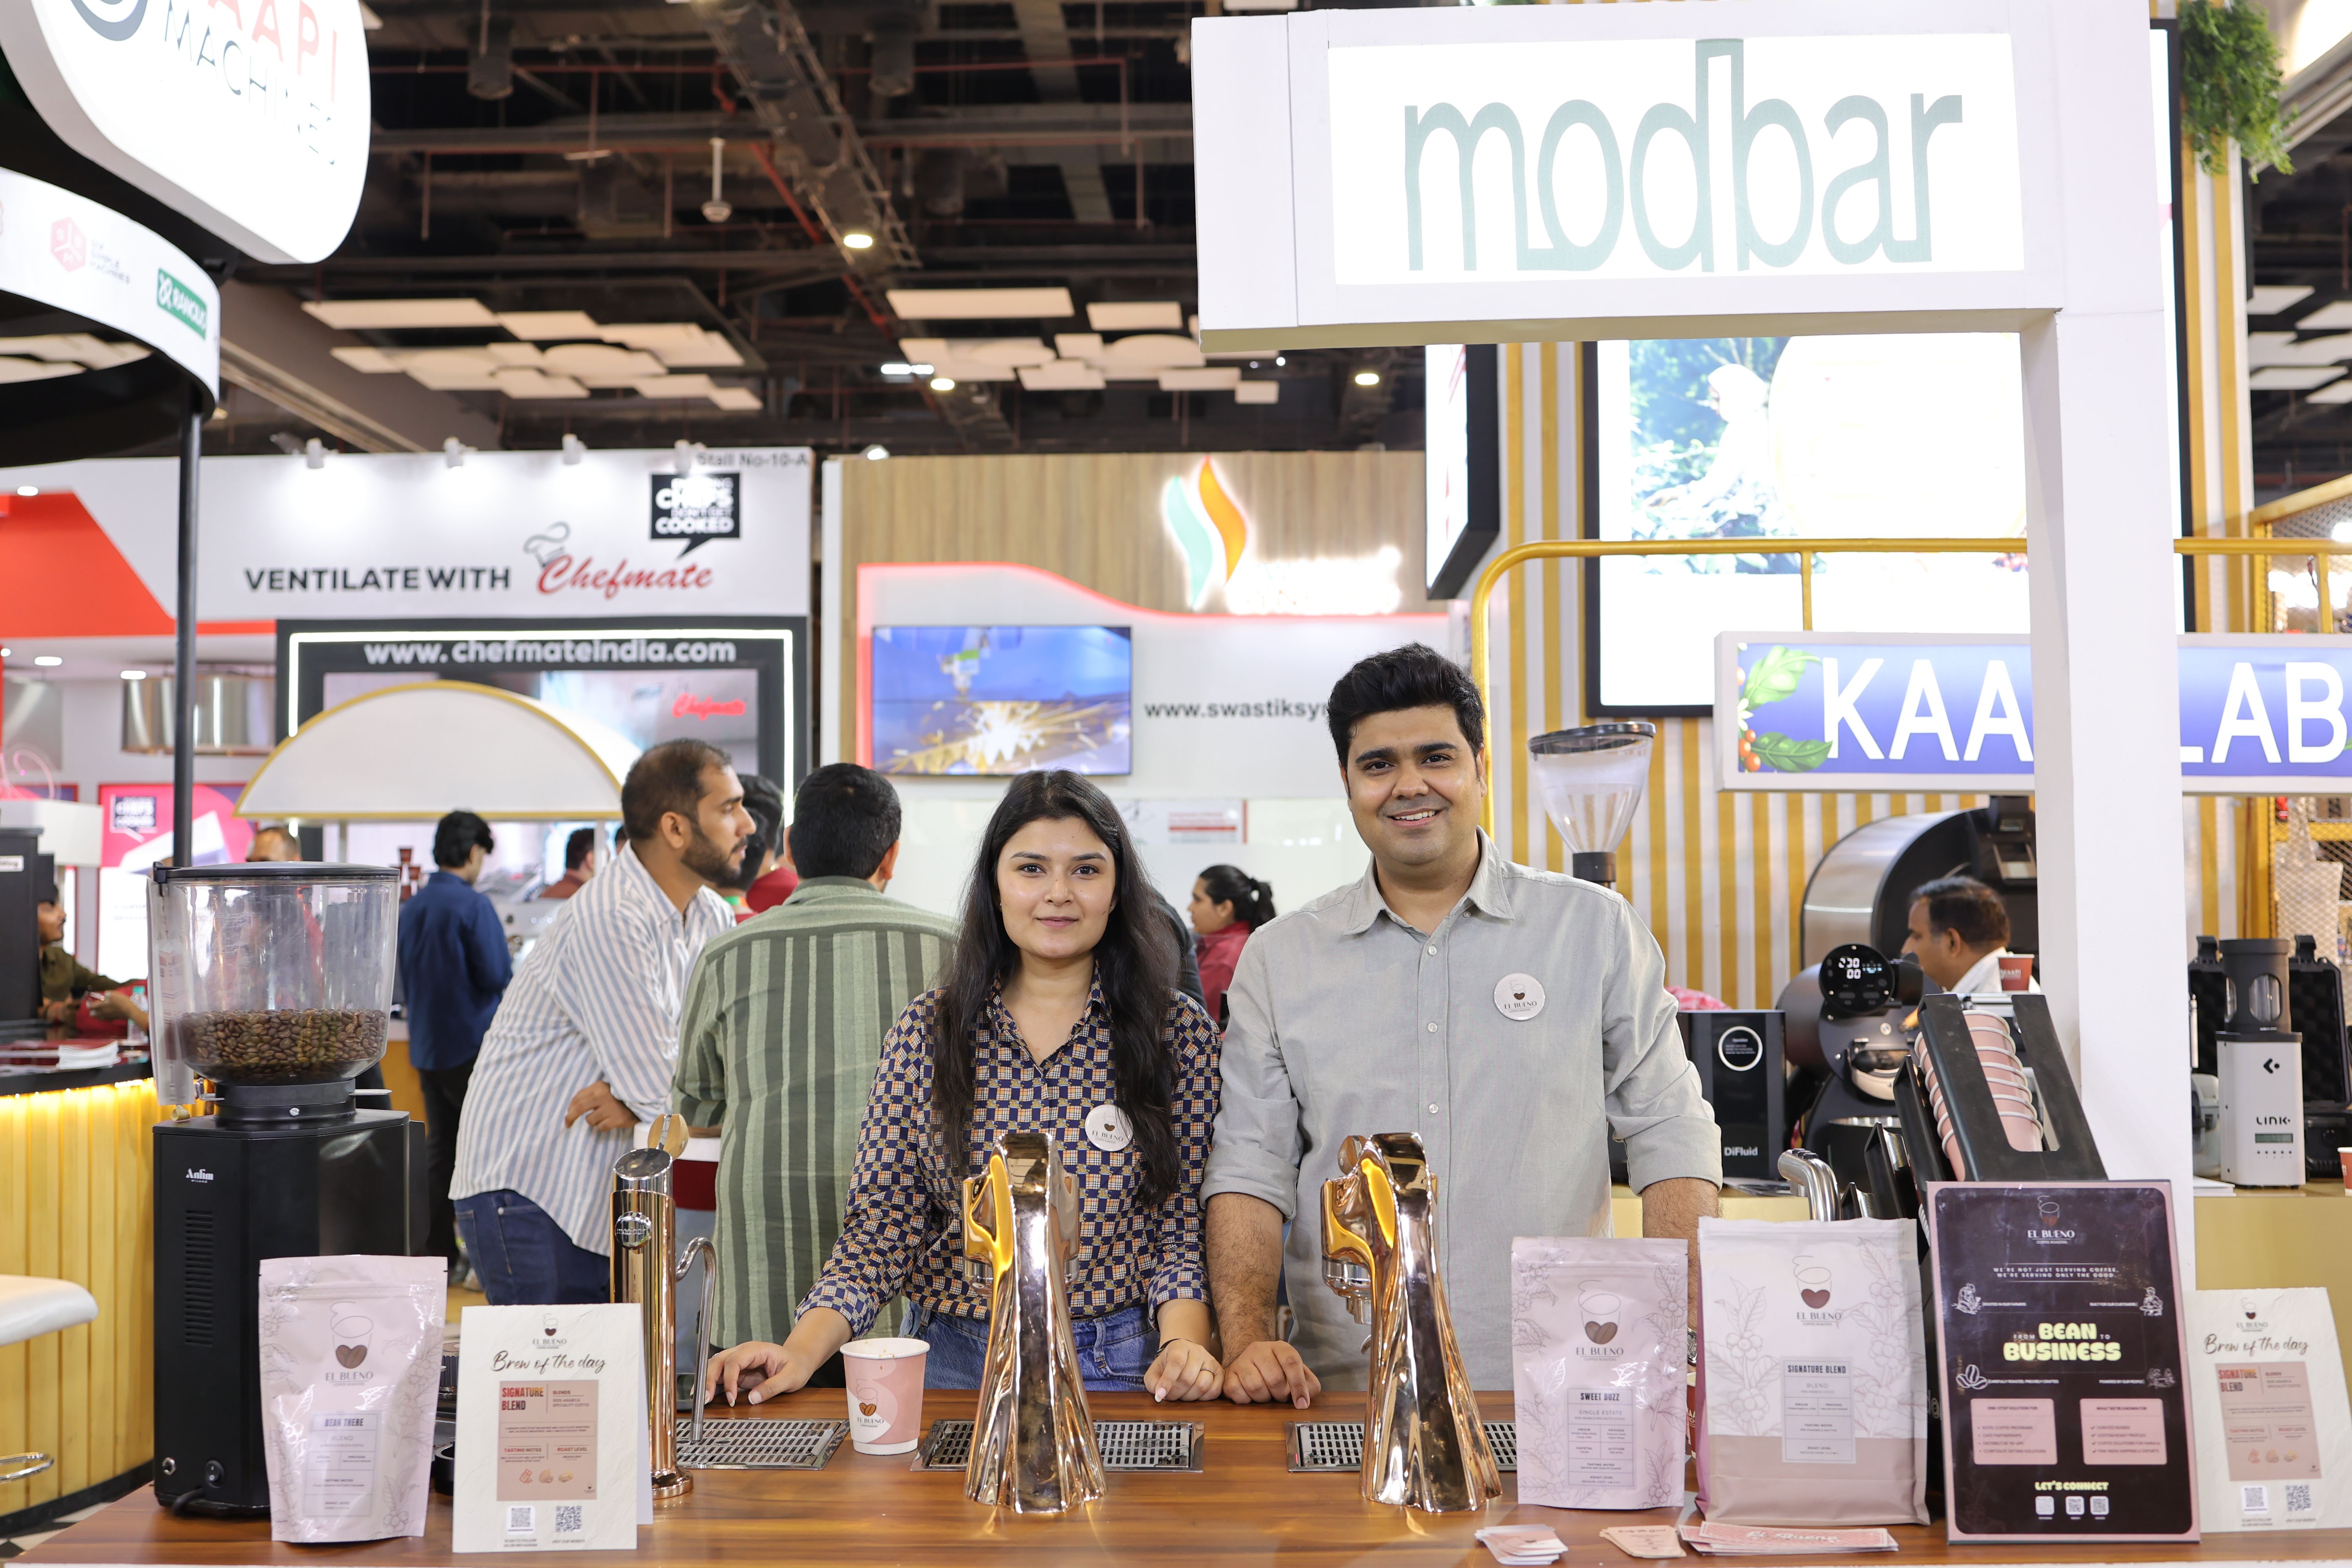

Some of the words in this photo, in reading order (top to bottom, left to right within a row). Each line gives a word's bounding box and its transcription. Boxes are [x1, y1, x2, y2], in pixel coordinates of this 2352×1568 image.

[165, 0, 336, 165] MACHIE
[1405, 38, 1962, 272] modbar
[696, 452, 734, 465] Stall
[739, 452, 809, 467] No-10-A
[655, 488, 734, 509] CHFS
[655, 516, 734, 535] COOKED
[245, 567, 419, 592] VENTILATE
[426, 567, 510, 590] WITH
[537, 554, 713, 599] Chefmate
[1846, 969, 1861, 979] 00
[1102, 1132, 1123, 1142] BUENO
[1724, 1146, 1758, 1156] DiFluid
[185, 1168, 214, 1180] Anfim
[2027, 1230, 2039, 1238] EL
[2042, 1230, 2075, 1238] BUENO
[1811, 1312, 1842, 1320] BUENO
[2038, 1322, 2097, 1340] BEAN
[1576, 1347, 1587, 1356] EL
[1591, 1347, 1624, 1356] BUENO
[2003, 1341, 2122, 1361] BUSINESS
[2203, 1334, 2239, 1354] Brew
[2243, 1340, 2258, 1357] of
[2258, 1336, 2281, 1351] the
[2283, 1336, 2309, 1356] day
[490, 1350, 531, 1372] Brew
[534, 1357, 550, 1375] of
[552, 1354, 575, 1369] the
[577, 1354, 607, 1374] day
[325, 1372, 337, 1381] EL
[340, 1371, 374, 1381] BUENO
[502, 1387, 544, 1397] SIGNATURE
[501, 1400, 526, 1410] BLEND
[344, 1418, 364, 1426] THERE
[2034, 1480, 2063, 1491] LET'S
[2063, 1481, 2109, 1491] CONNECT
